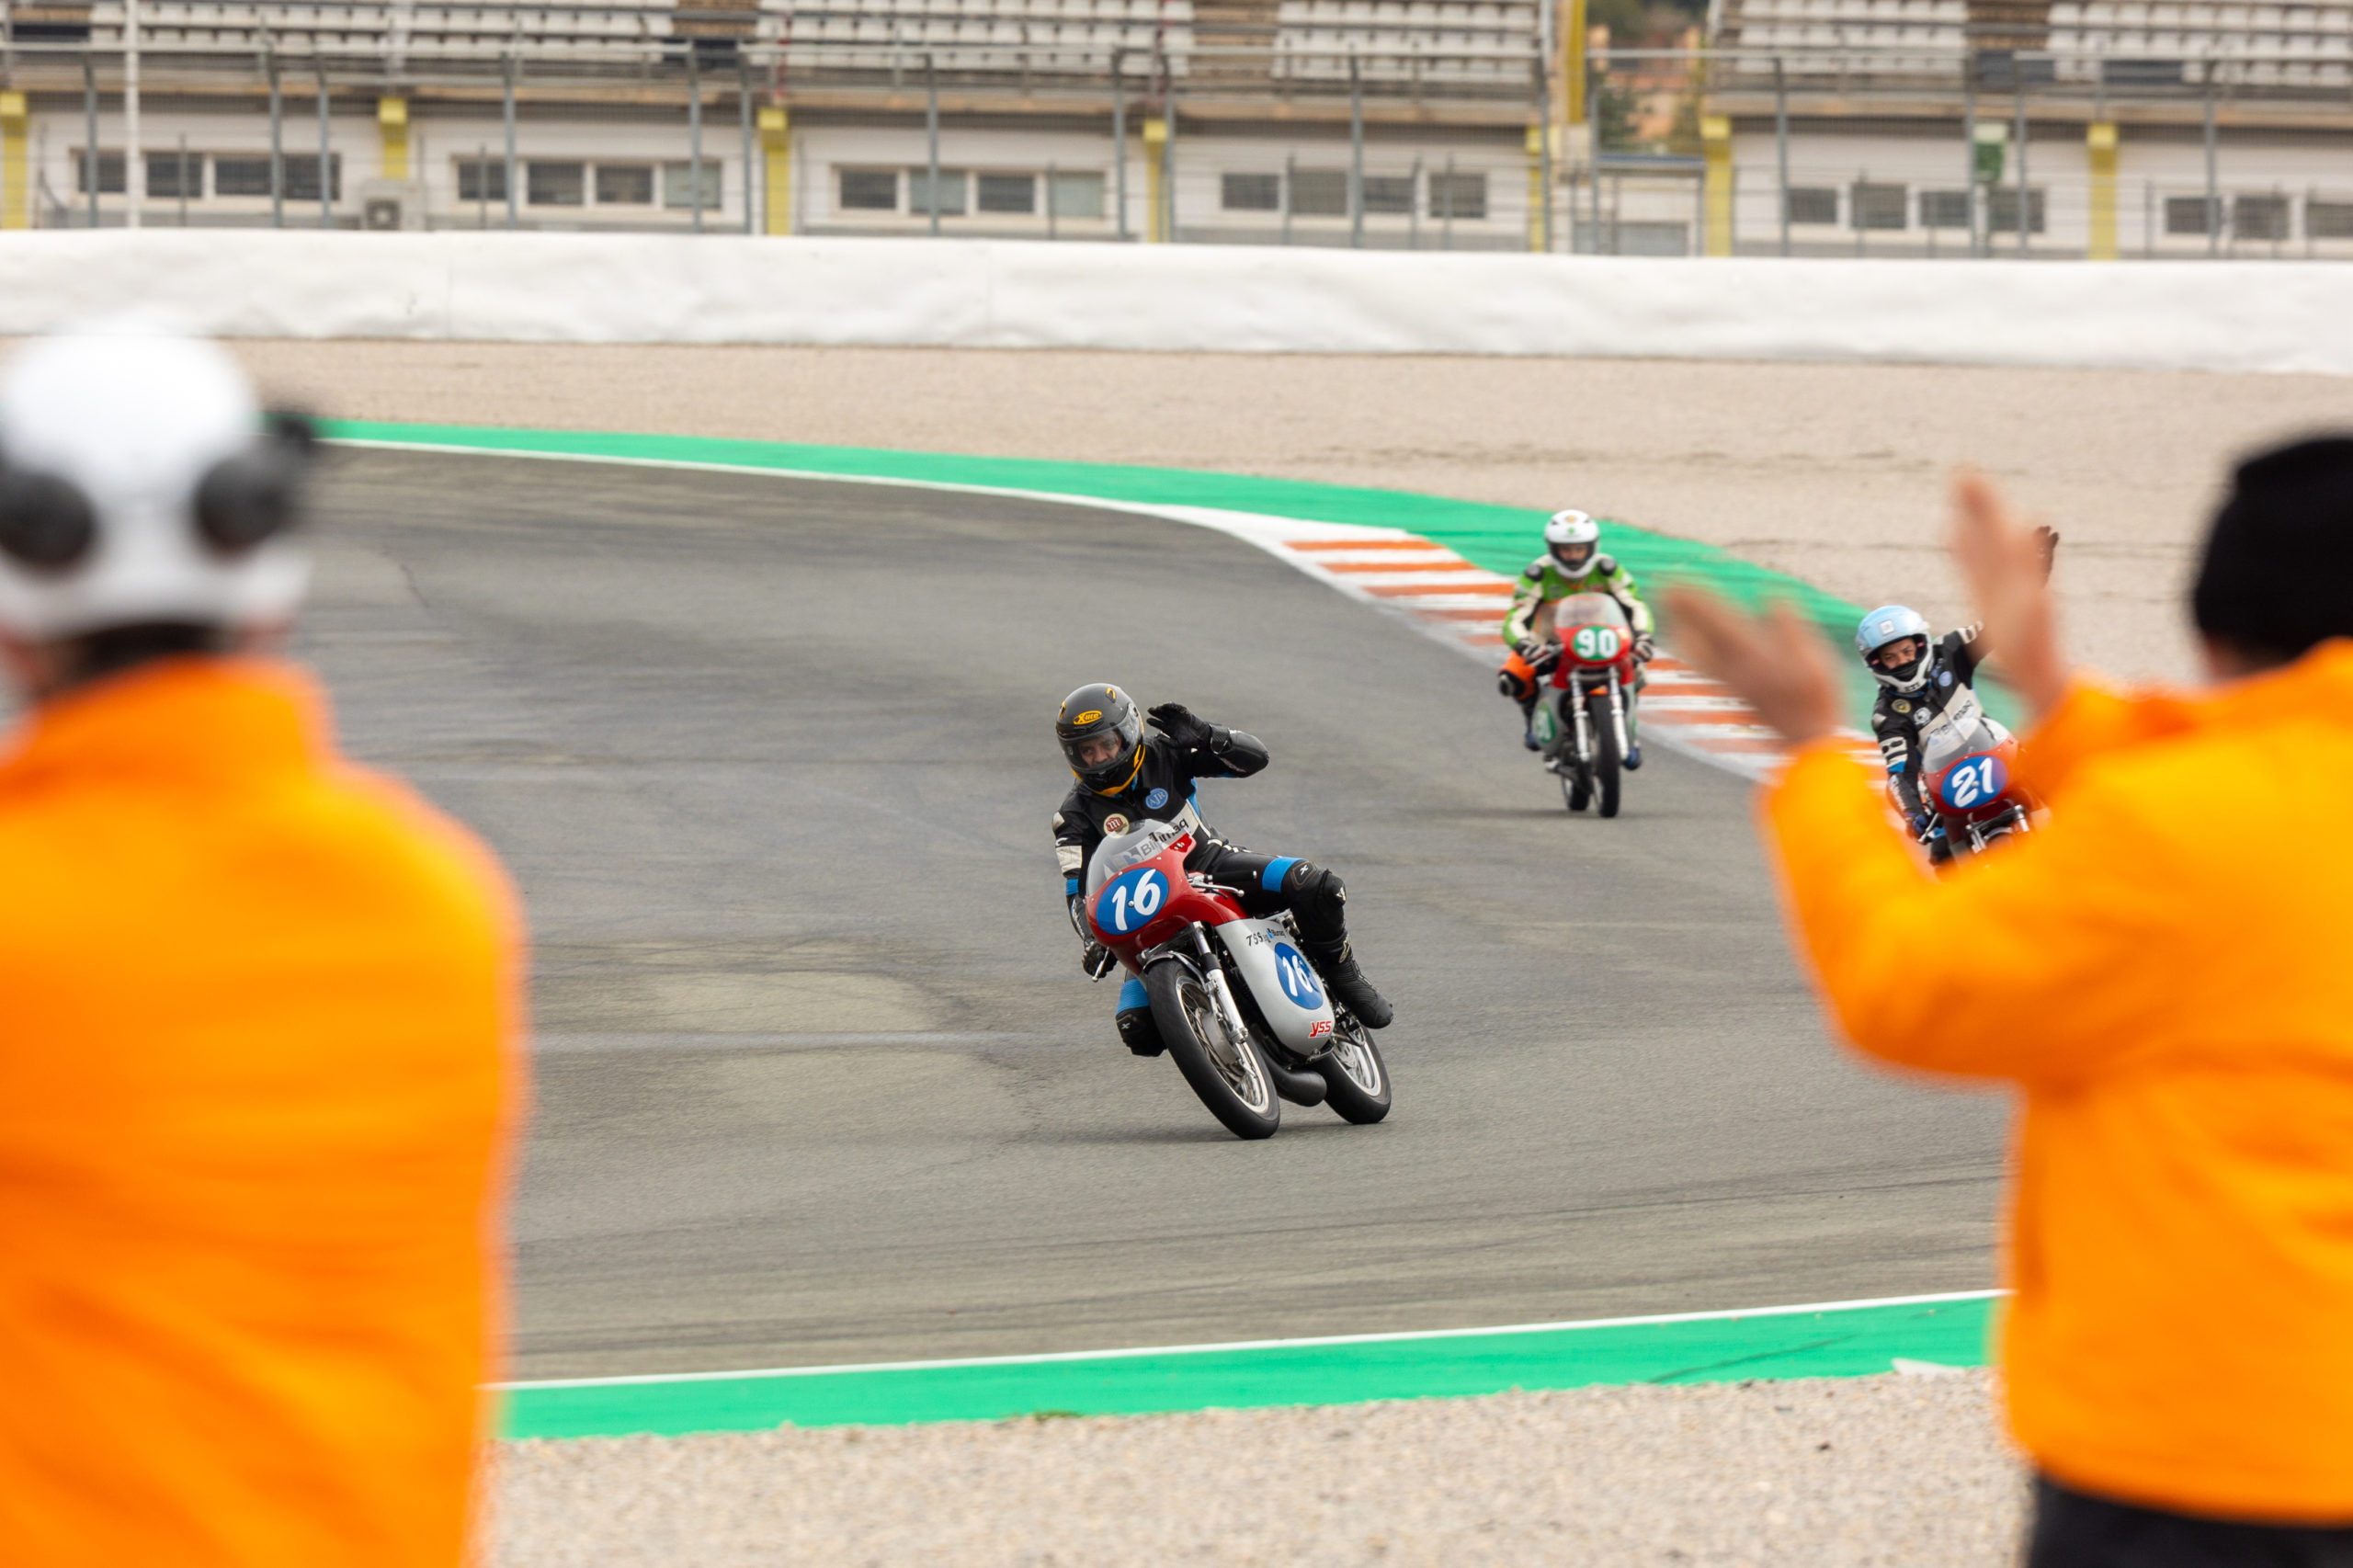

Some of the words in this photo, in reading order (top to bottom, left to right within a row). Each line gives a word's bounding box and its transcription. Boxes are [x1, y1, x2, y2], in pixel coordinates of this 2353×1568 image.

[1576, 628, 1619, 661] 90
[1148, 790, 1165, 806] AJR
[1951, 757, 1995, 808] 21
[1111, 869, 1161, 931] 16
[1282, 955, 1313, 997] 16
